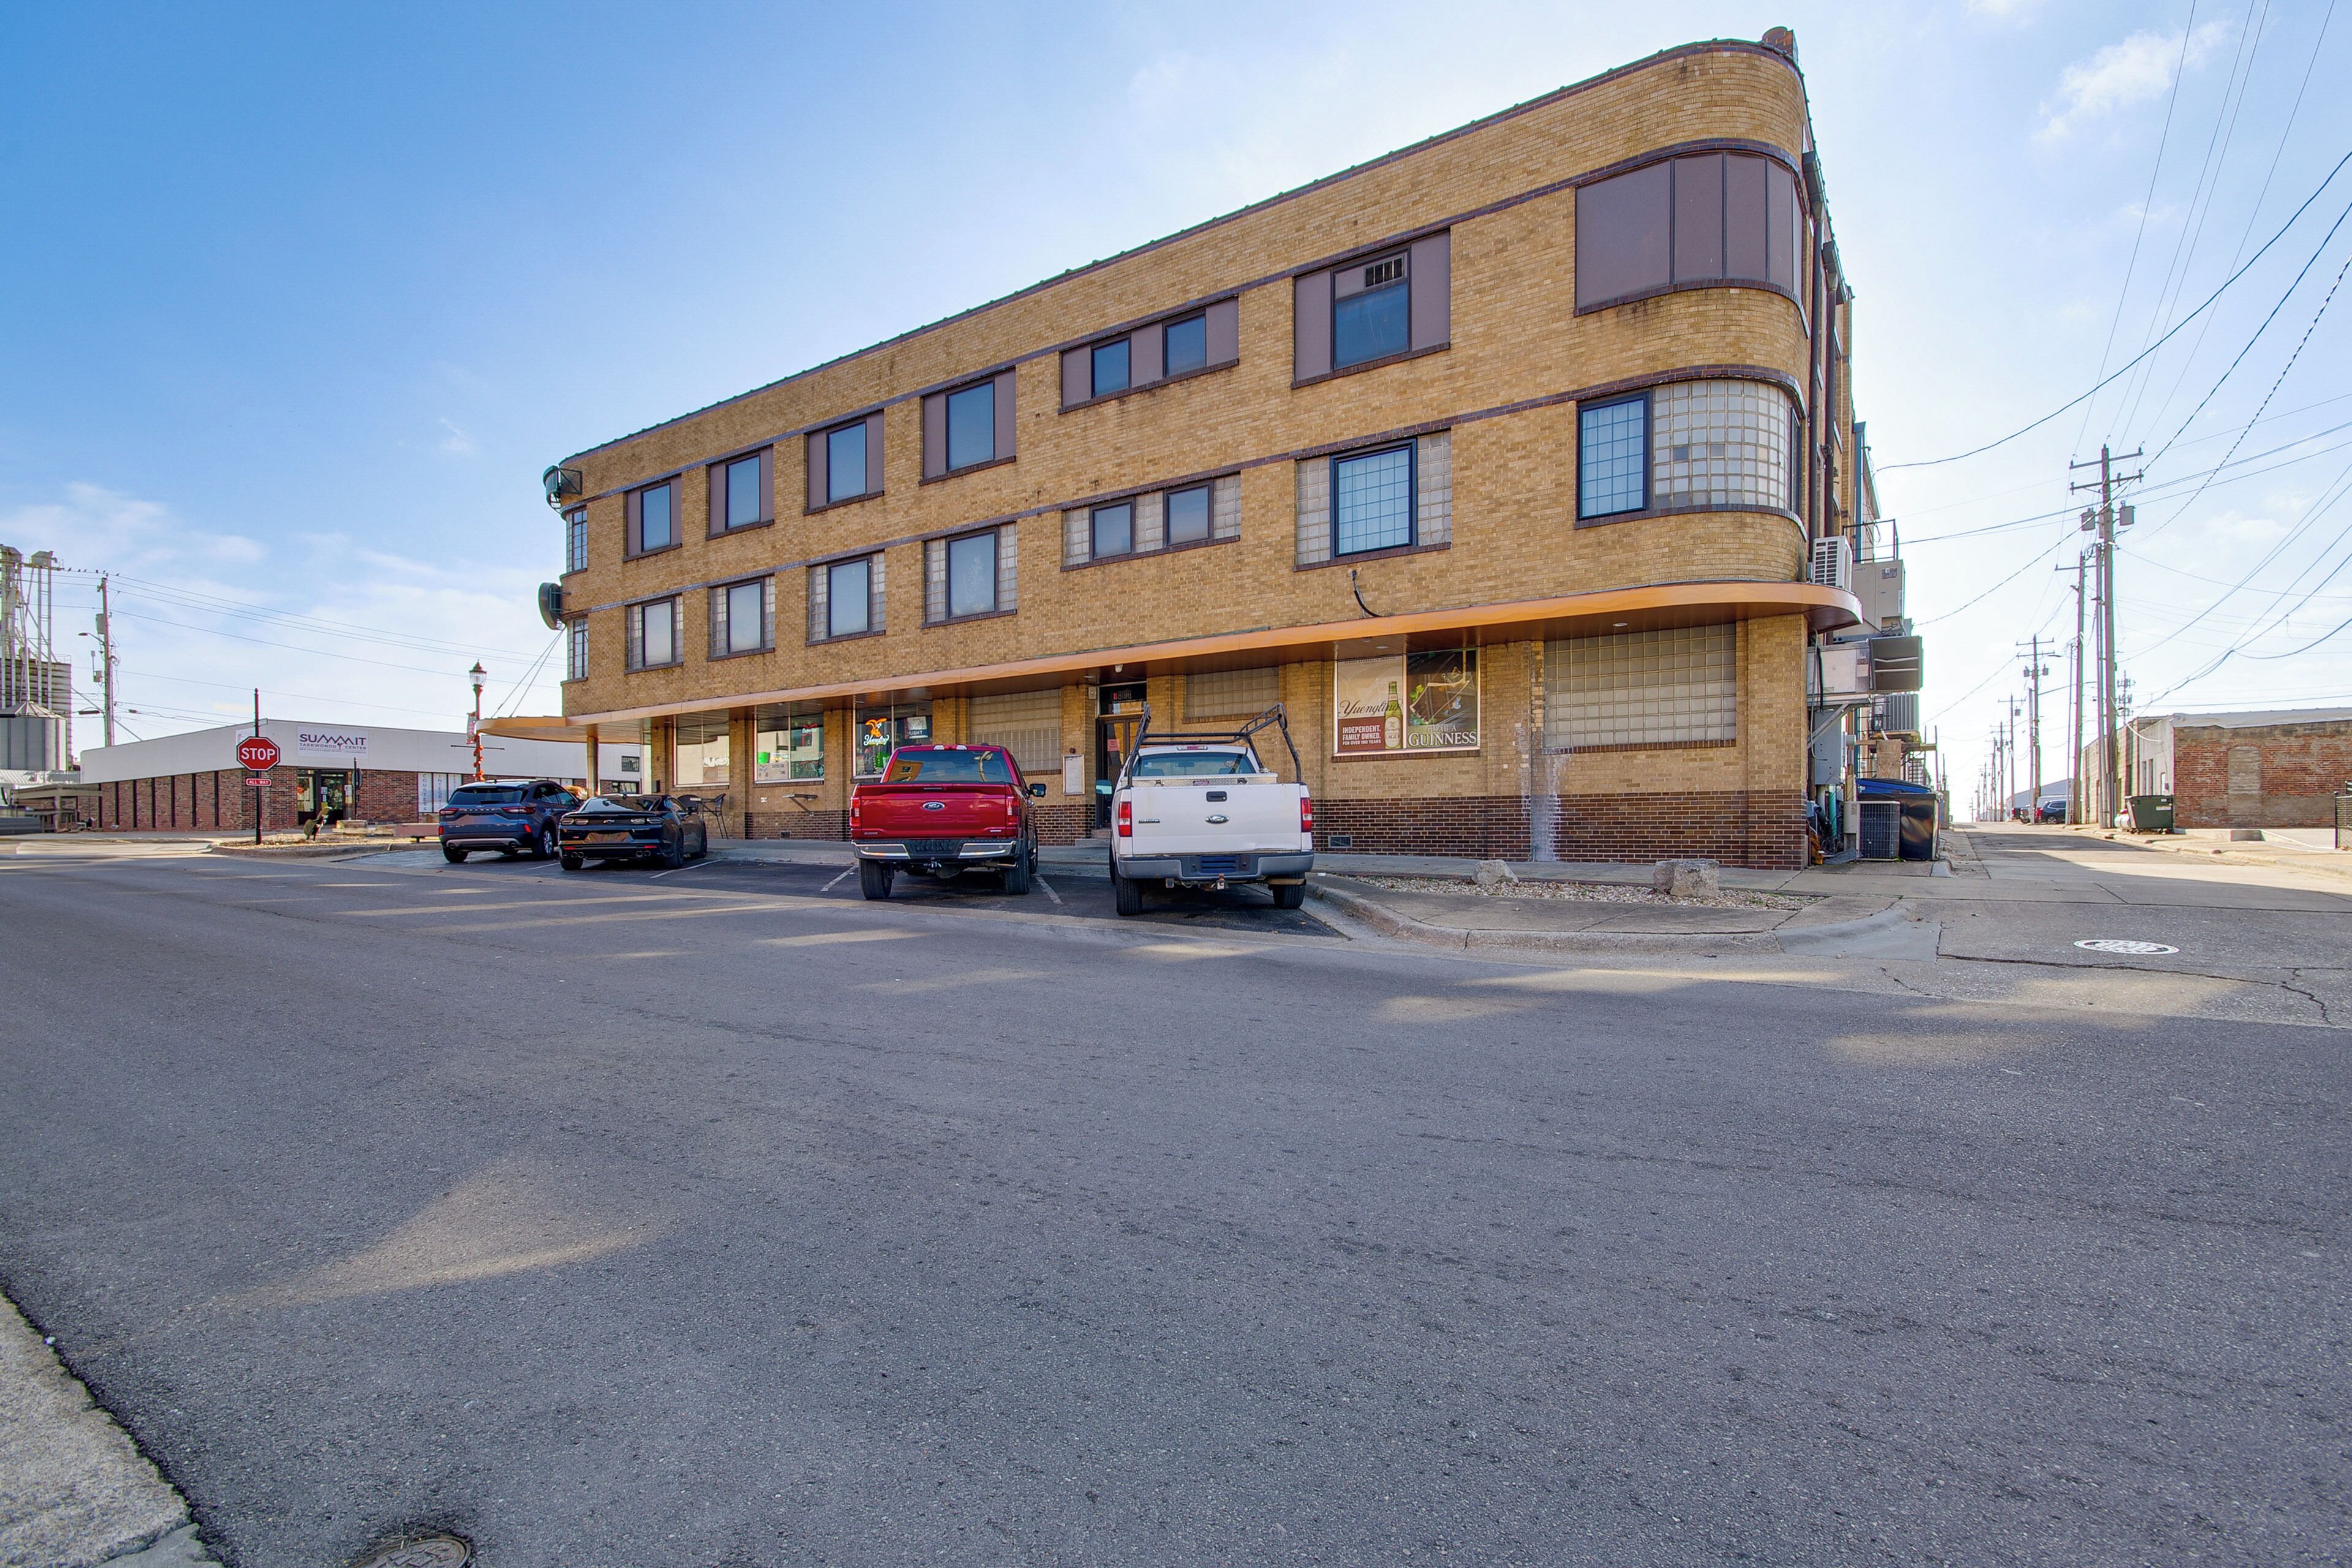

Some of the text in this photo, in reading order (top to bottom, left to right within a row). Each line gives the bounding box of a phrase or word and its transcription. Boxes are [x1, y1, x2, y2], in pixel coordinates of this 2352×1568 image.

[1343, 725, 1381, 734] INDEPENDENT.
[1409, 731, 1477, 747] GUINNESS
[241, 747, 276, 761] STOP
